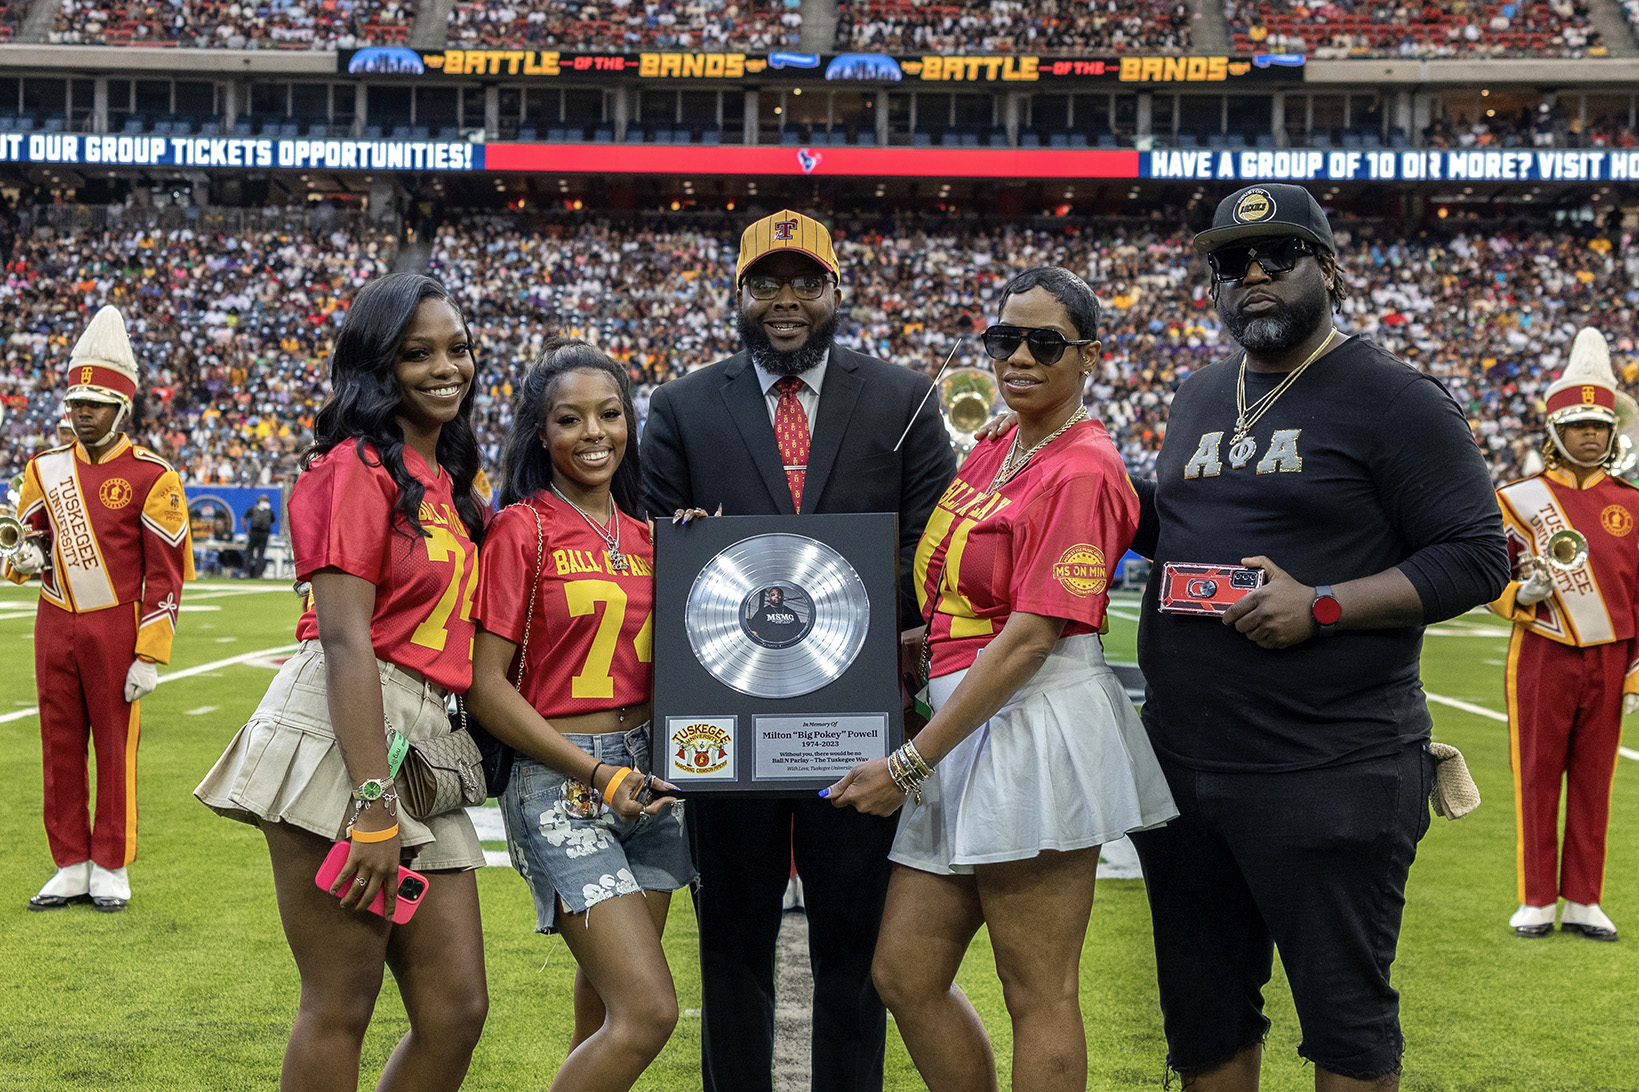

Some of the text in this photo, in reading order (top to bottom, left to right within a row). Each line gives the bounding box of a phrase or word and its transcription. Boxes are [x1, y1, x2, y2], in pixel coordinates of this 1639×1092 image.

[444, 50, 746, 78] BATTLE OF THE BANDS
[921, 55, 1229, 82] BATTLE OF THE BANDS
[29, 135, 79, 162] OUR
[85, 136, 166, 164] GROUP
[171, 137, 272, 166] TICKETS
[278, 139, 473, 169] OPPORTUNITIES!
[1151, 150, 1213, 178] HAVE
[1217, 151, 1235, 178] A
[1240, 151, 1324, 178] GROUP
[1328, 151, 1361, 179] OF
[1366, 151, 1395, 179] 10
[1447, 151, 1534, 180] MORE?
[1537, 151, 1605, 180] VISIT
[48, 488, 81, 568] UNIVERSITY
[60, 476, 99, 571] TUSKEGEE
[552, 549, 603, 576] BALL
[1056, 566, 1071, 577] MS
[1073, 566, 1087, 577] ON
[672, 723, 732, 744] TUSKEGEE
[684, 733, 719, 744] UNIVERSITY
[762, 731, 792, 740] Milton
[847, 729, 878, 738] Powell
[801, 740, 840, 748] 1974-2023
[674, 759, 695, 773] MARCHING
[790, 757, 810, 765] Parlay
